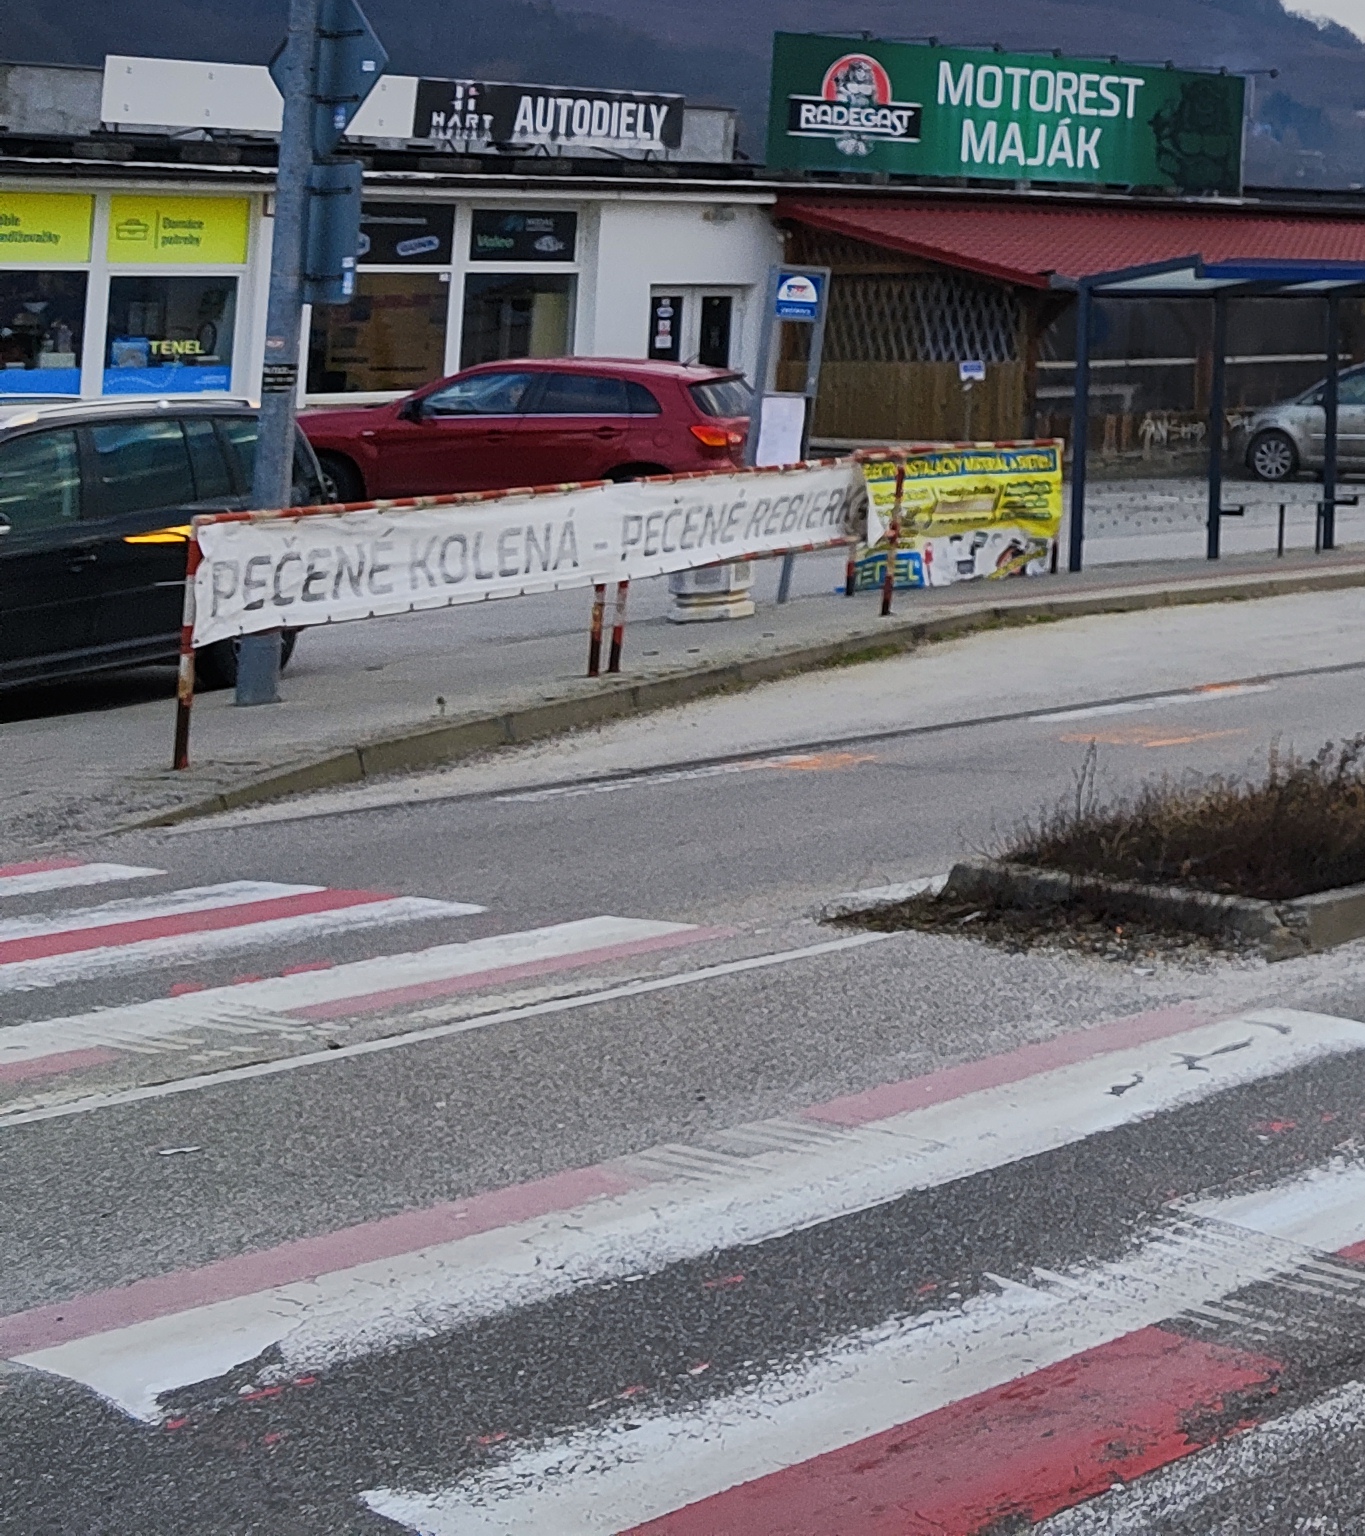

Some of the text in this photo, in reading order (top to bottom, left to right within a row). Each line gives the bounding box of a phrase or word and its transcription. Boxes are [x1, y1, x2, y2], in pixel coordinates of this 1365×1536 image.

[937, 60, 1145, 119] MOTOREST
[431, 111, 495, 130] HART
[513, 95, 670, 141] AUTODIELY
[800, 103, 915, 136] RADEGAST
[960, 118, 1103, 170] MAJÁK
[151, 340, 206, 355] TENEL
[209, 526, 396, 617] PEČENÉ
[409, 507, 580, 591] KOLENÁ
[620, 488, 748, 562] PEČENÉ
